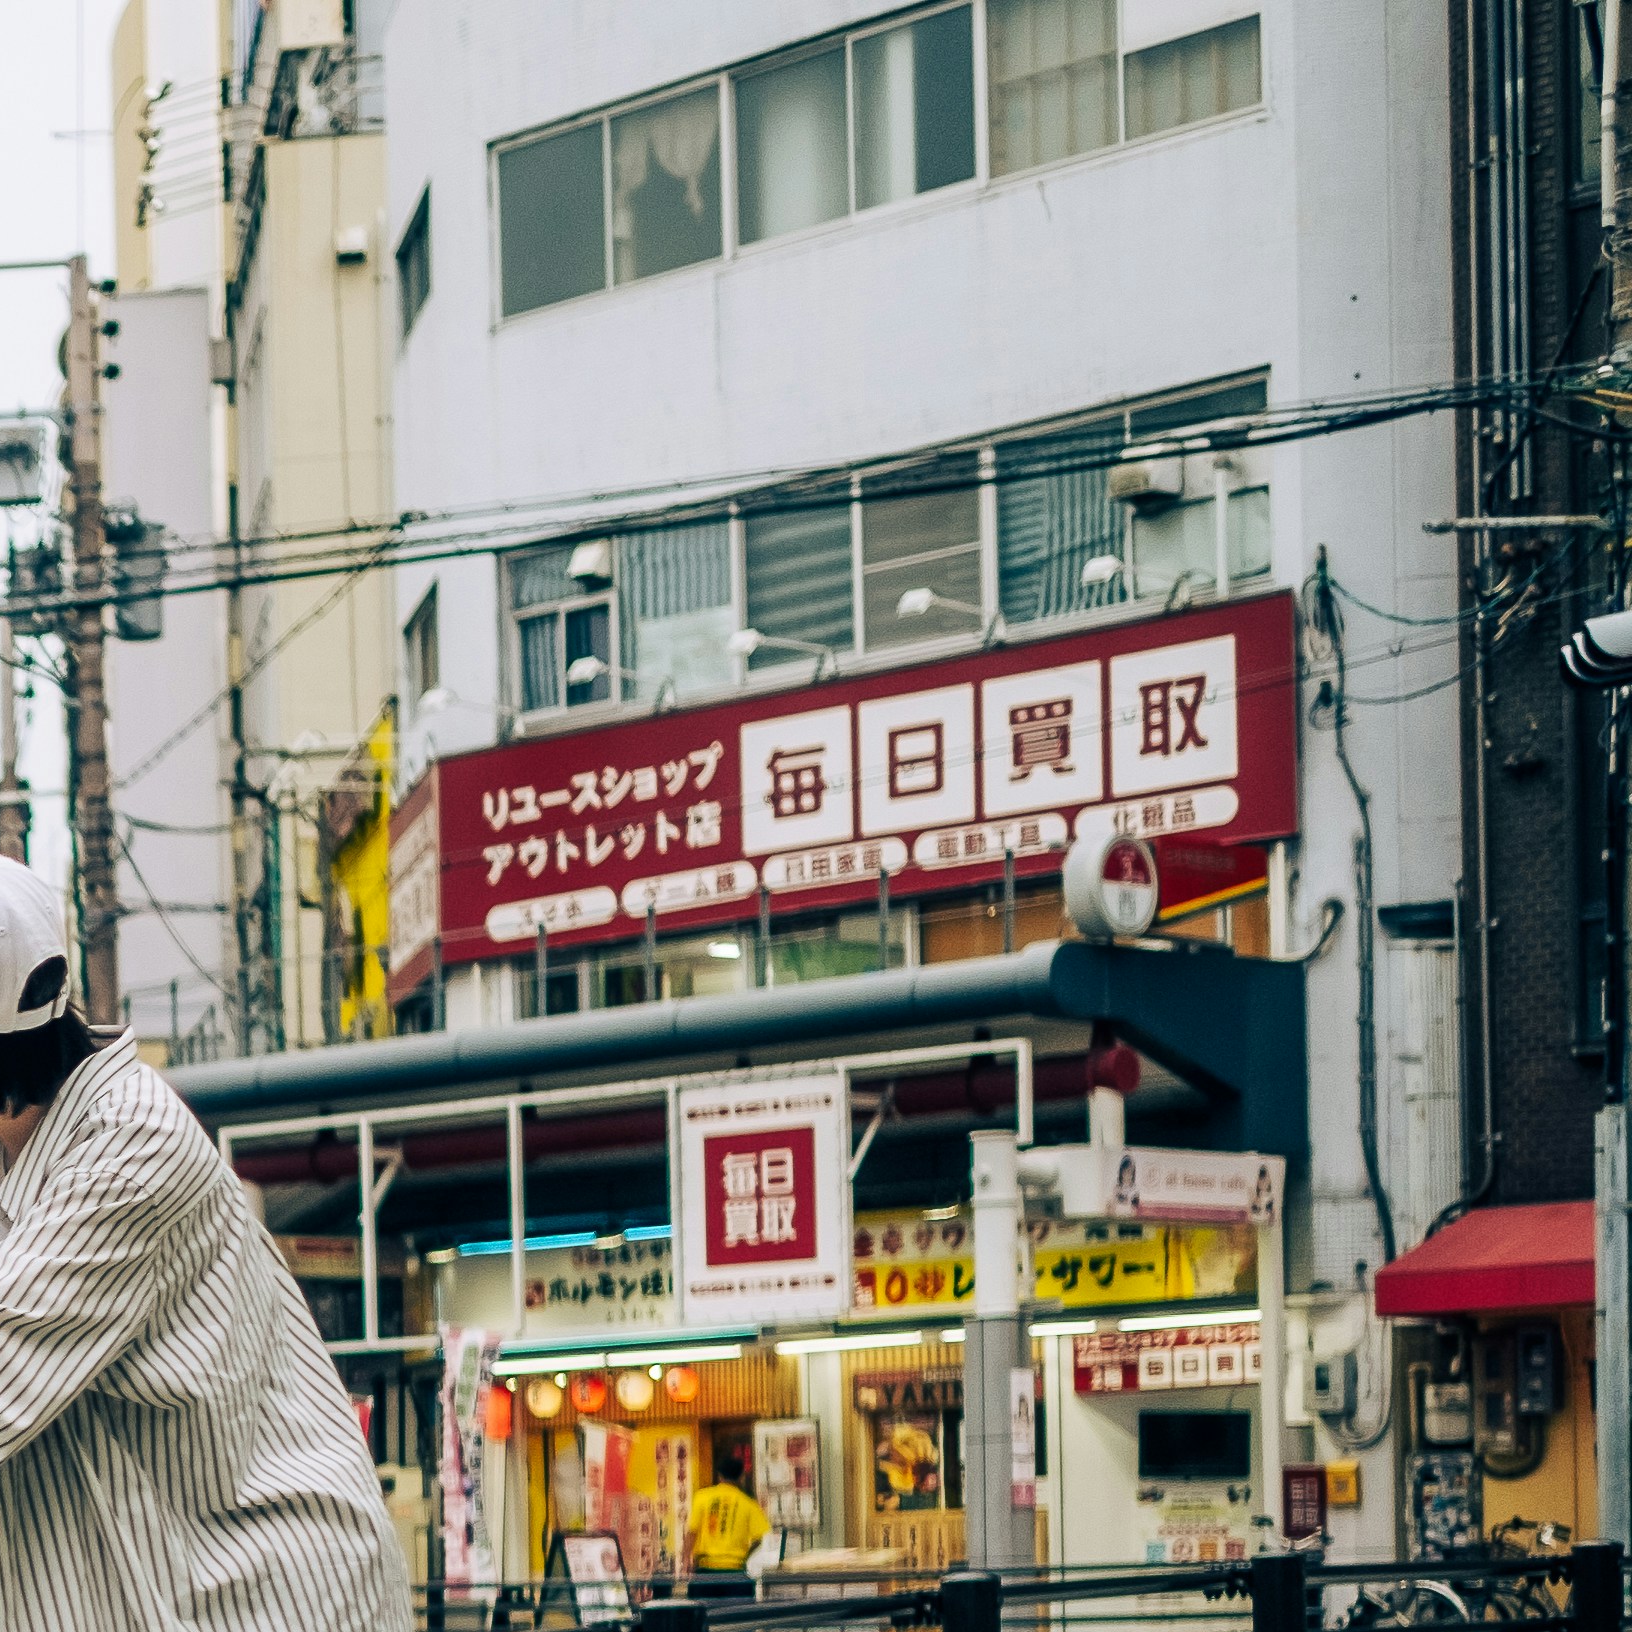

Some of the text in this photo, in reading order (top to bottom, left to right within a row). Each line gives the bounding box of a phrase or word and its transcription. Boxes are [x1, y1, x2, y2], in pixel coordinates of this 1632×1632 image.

[482, 740, 724, 832] リユースショップ
[766, 674, 1210, 820] 毎日買取
[482, 799, 722, 887] アウトレット店
[722, 1147, 794, 1198] 毎日
[723, 1197, 797, 1248] 買取
